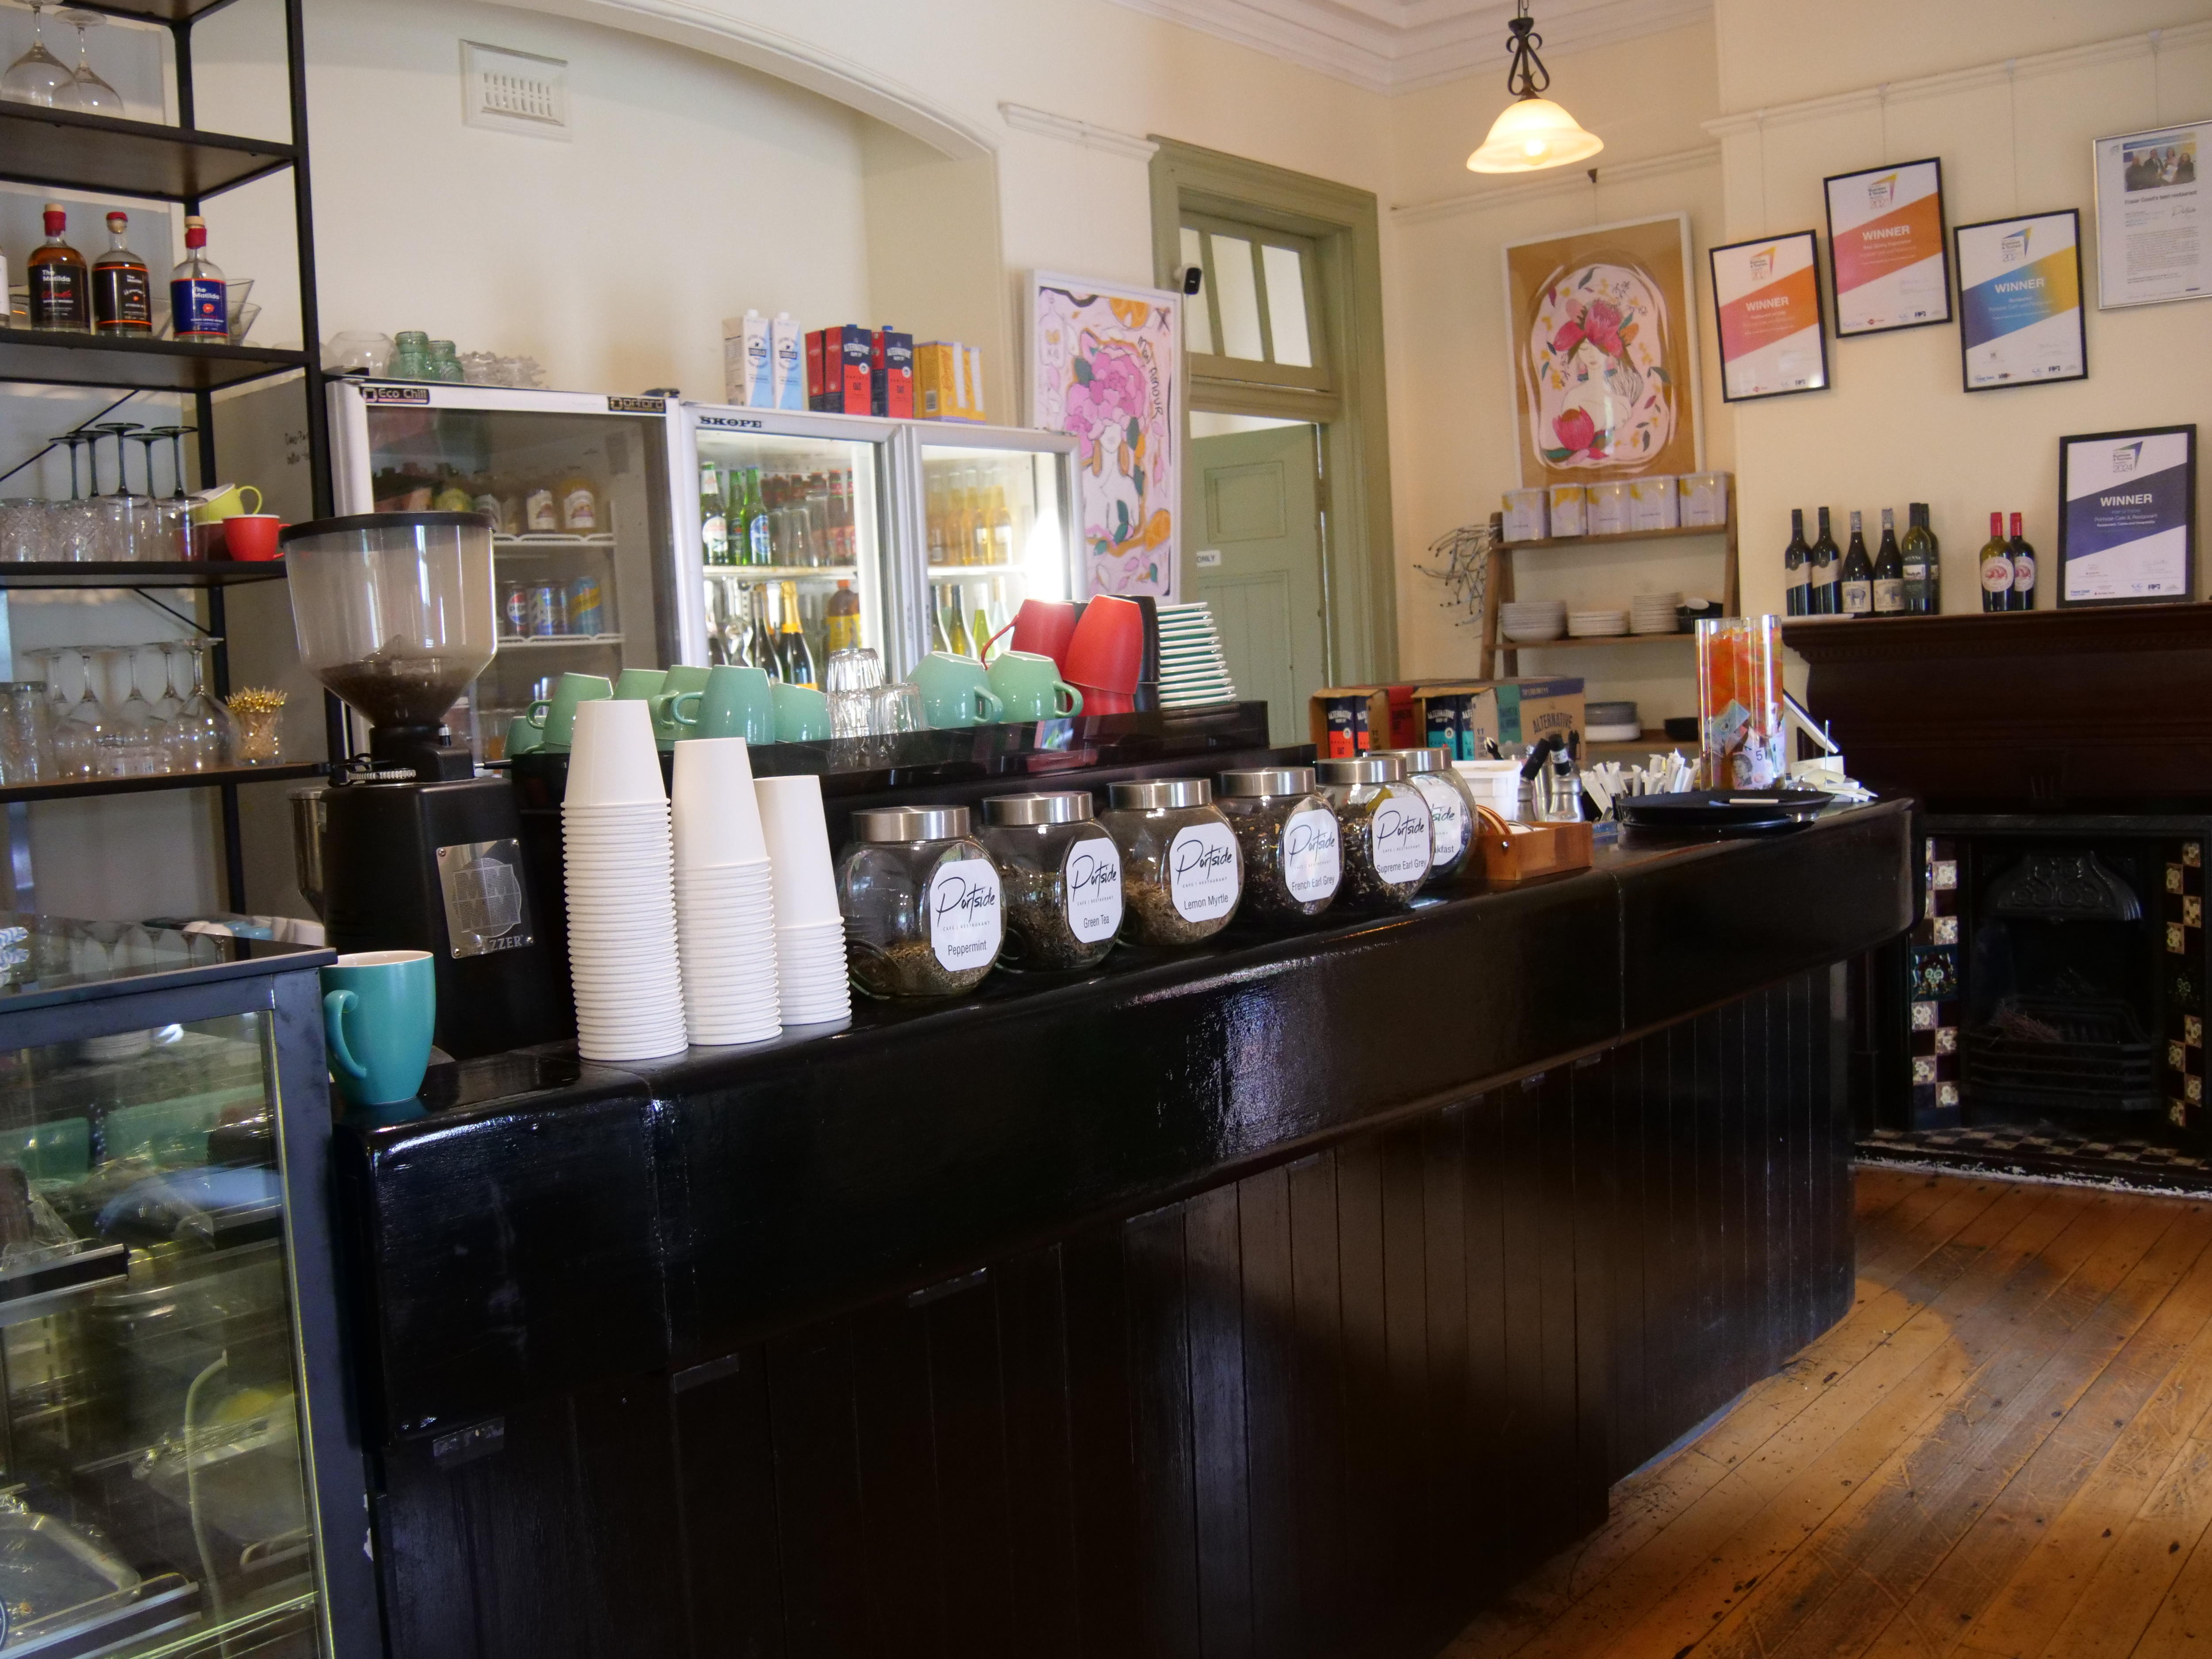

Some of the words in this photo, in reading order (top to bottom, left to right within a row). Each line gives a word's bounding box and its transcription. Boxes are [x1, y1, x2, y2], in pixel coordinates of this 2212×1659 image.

[1863, 225, 1910, 240] WINNER
[1994, 278, 2044, 293] WINNER
[1746, 296, 1789, 311] WINNER
[378, 388, 400, 398] Eco
[403, 389, 427, 399] Chill
[699, 415, 762, 428] SKOPE
[2112, 464, 2132, 473] 2024
[2100, 493, 2153, 507] WINNER
[1196, 555, 1215, 563] ONLY
[1427, 709, 1455, 720] ALTERNATIVE
[1532, 712, 1573, 734] ALTERNATIVE
[1756, 750, 1763, 761] 5
[1376, 810, 1425, 850] Portside
[1288, 824, 1335, 867] Portside
[1175, 839, 1232, 885] Portside
[1377, 864, 1402, 874] Supreme
[1402, 860, 1413, 870] Earl
[1414, 859, 1427, 868] Grey
[1071, 855, 1117, 902] Portside
[1199, 876, 1228, 885] RESTAURANT
[1292, 880, 1311, 891] French
[1312, 877, 1322, 887] Earl
[1323, 876, 1335, 885] Grey
[935, 876, 995, 927] Portside
[1184, 899, 1206, 910] Lemon
[1208, 893, 1229, 907] Myrtle
[1083, 918, 1100, 929] Green
[1100, 914, 1110, 925] Tea
[948, 940, 987, 957] Peppermint
